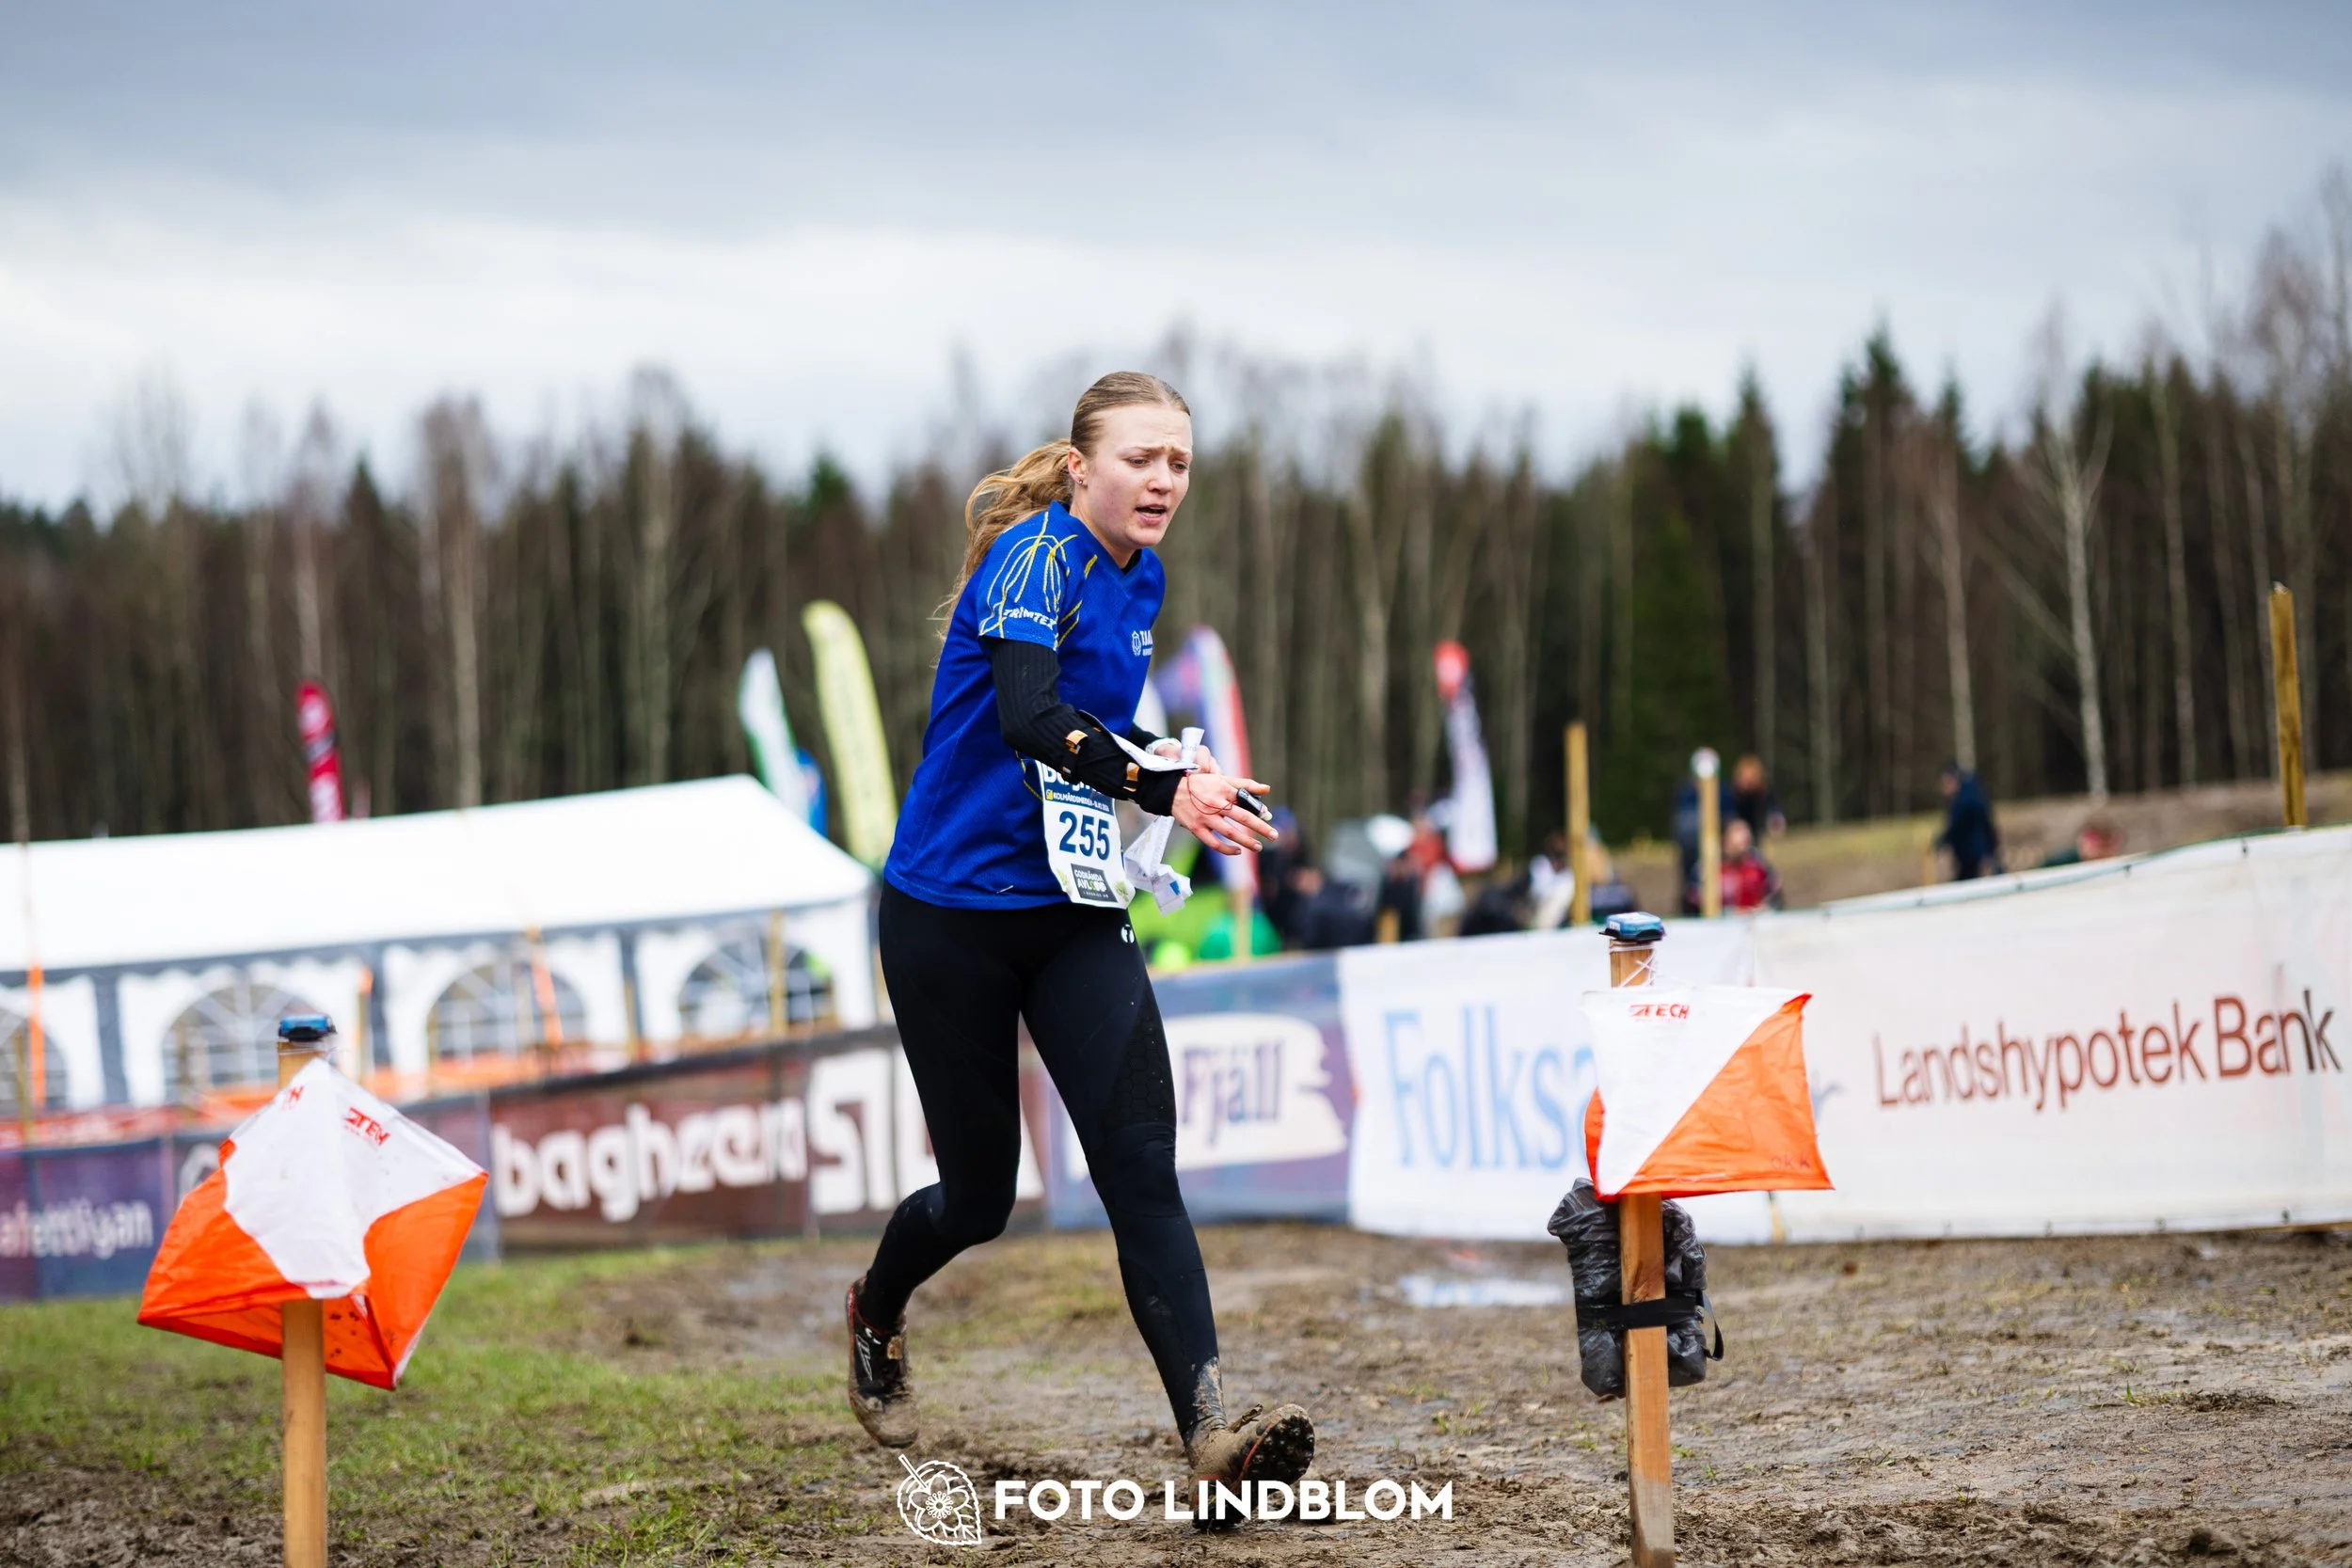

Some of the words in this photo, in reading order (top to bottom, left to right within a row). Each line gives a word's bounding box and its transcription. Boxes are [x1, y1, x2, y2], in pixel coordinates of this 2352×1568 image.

[1003, 606, 1057, 630] TRIMTEX
[1058, 810, 1110, 861] 255
[1871, 999, 2206, 1112] Landshypotek
[2213, 988, 2342, 1078] Bank
